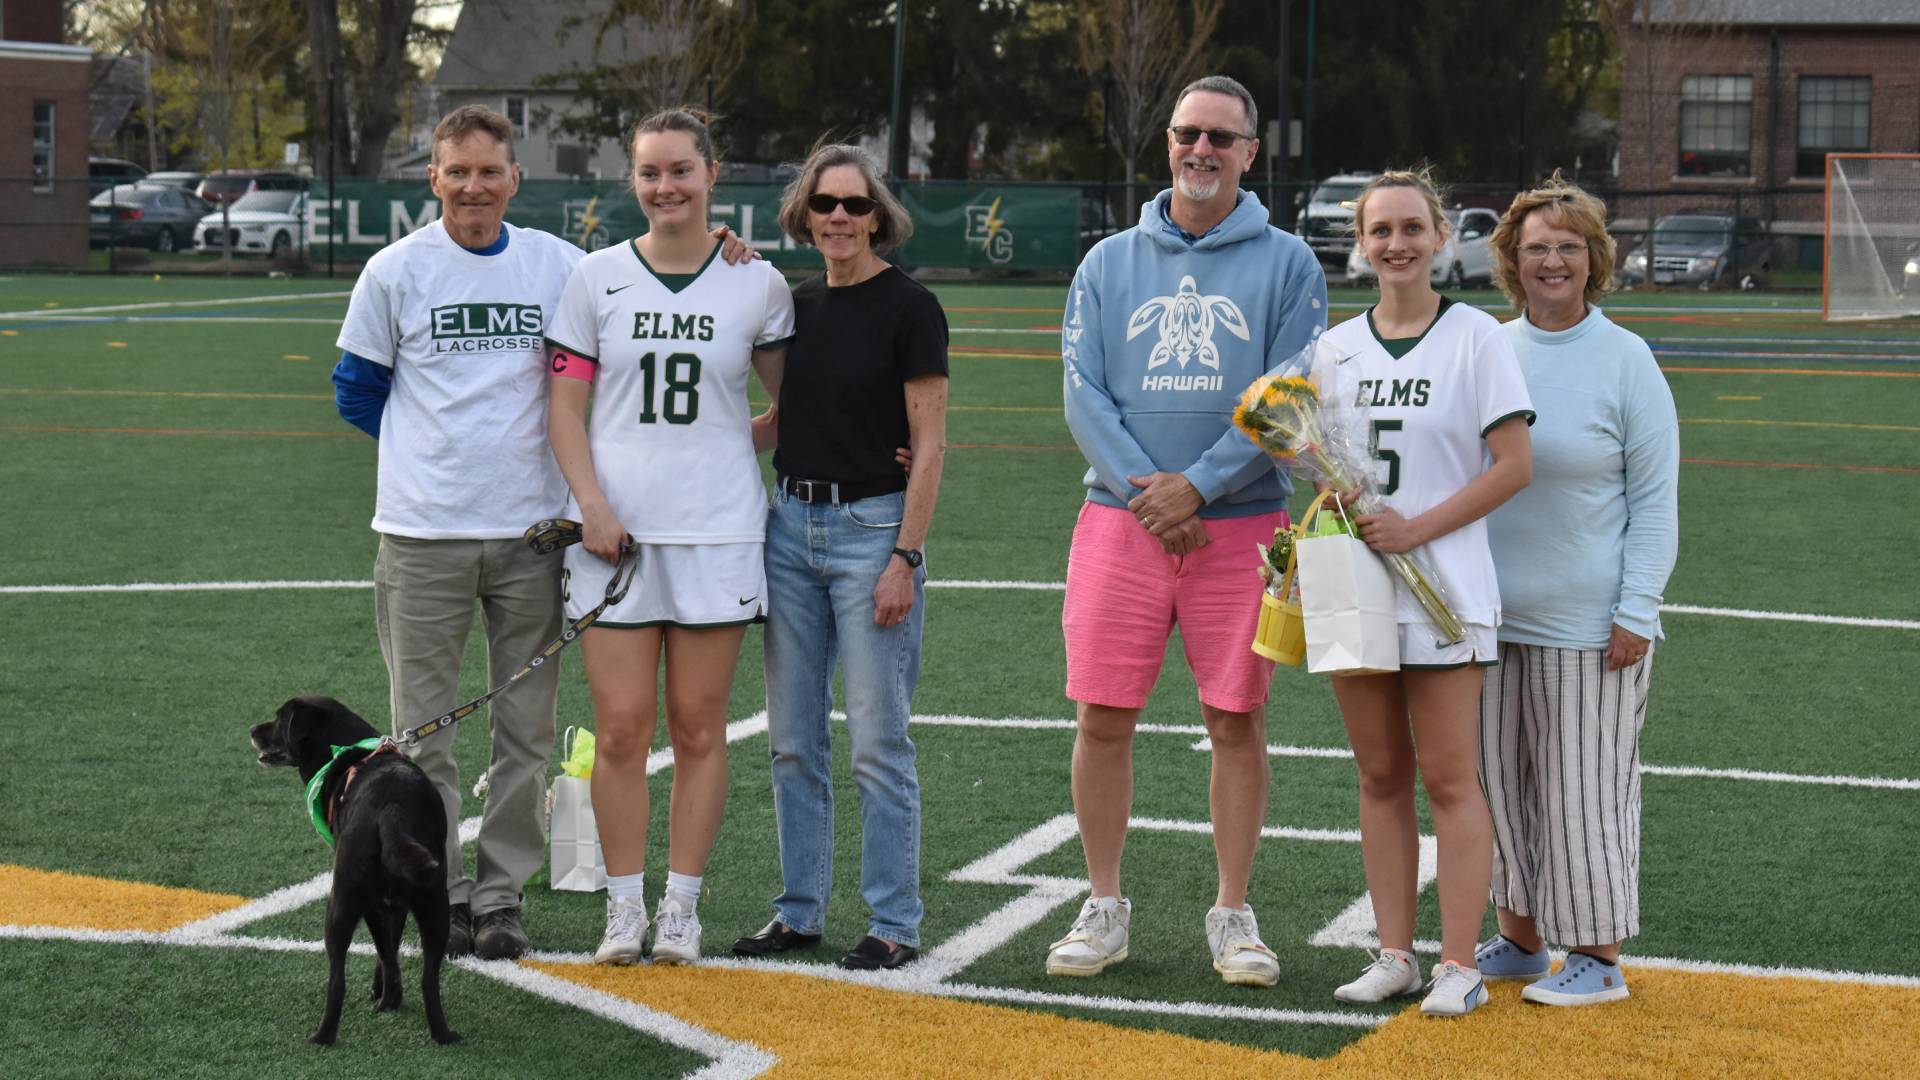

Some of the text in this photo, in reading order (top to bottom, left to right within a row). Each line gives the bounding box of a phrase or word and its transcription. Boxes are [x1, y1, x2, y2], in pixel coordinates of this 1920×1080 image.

[306, 199, 440, 244] ELM
[434, 306, 543, 336] ELMS
[632, 311, 715, 342] ELMS
[436, 338, 541, 353] LACROSSE
[552, 353, 568, 373] C
[639, 352, 702, 425] 18
[1141, 375, 1224, 391] HAWAII
[1354, 378, 1431, 407] ELMS
[1367, 419, 1403, 496] 5
